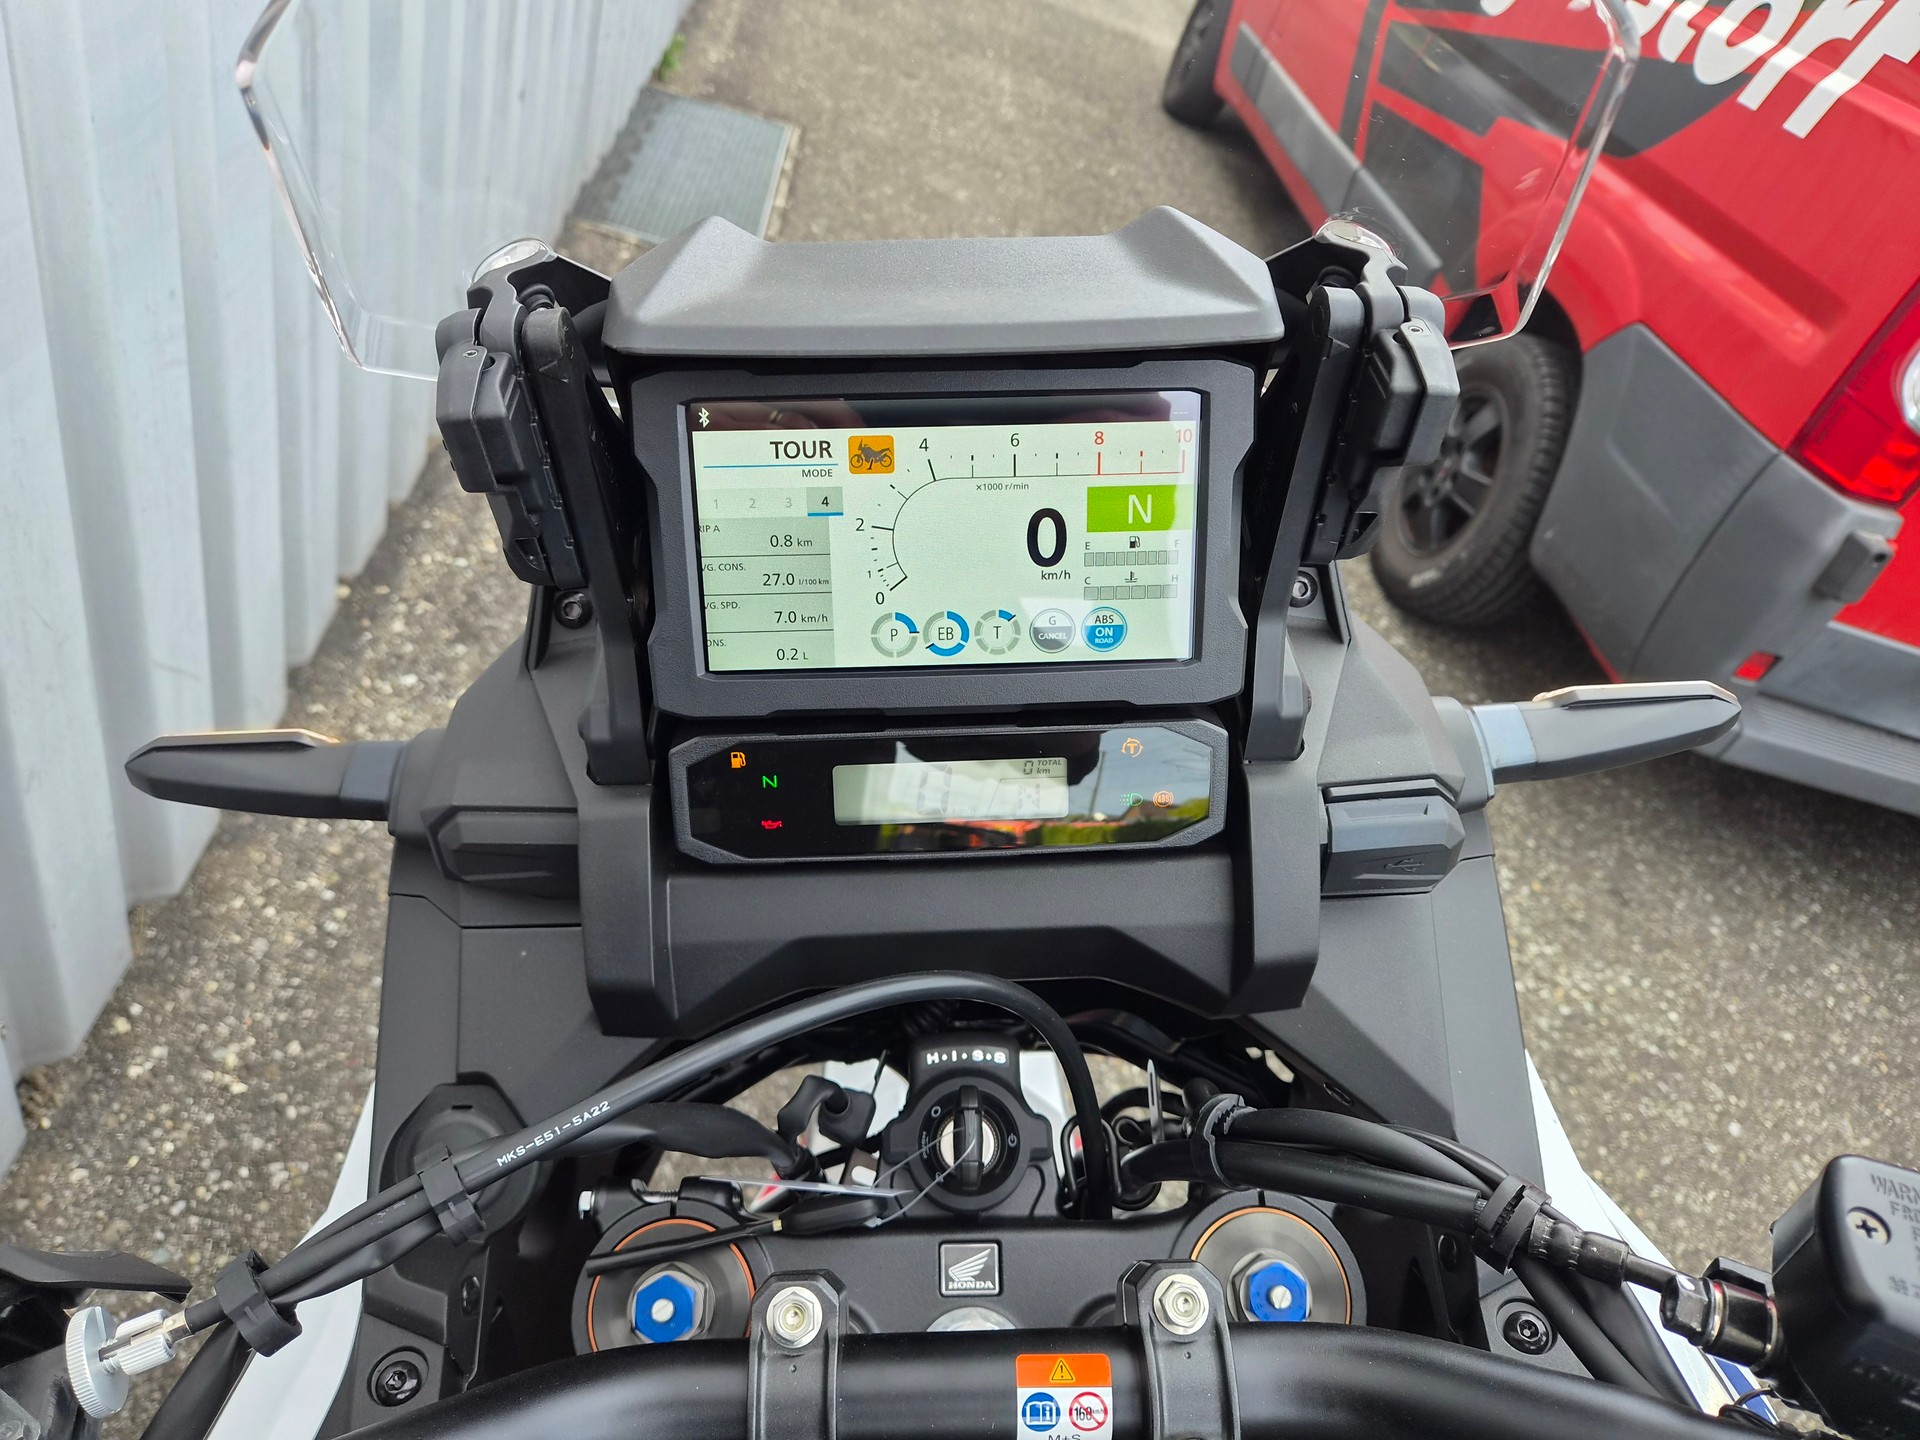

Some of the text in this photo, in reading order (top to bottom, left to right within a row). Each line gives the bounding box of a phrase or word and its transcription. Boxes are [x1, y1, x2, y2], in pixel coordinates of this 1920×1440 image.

[1010, 433, 1020, 447] 6
[1094, 431, 1105, 445] 8
[1176, 428, 1193, 443] 10
[769, 440, 833, 460] TOUR
[919, 438, 930, 452] 4
[801, 468, 833, 478] MODE
[1005, 482, 1030, 491] r/min
[713, 496, 830, 509] 1 2 3 4
[1127, 494, 1153, 524] N
[713, 524, 721, 533] A
[855, 517, 866, 531] 2
[769, 534, 813, 548] 0.8 km
[1026, 507, 1068, 568] 0
[1174, 539, 1180, 548] F
[1085, 542, 1091, 551] E
[718, 563, 746, 572] CONS.
[762, 573, 795, 587] 27.0
[867, 570, 872, 579] 1
[1040, 570, 1071, 581] km/h
[1084, 577, 1091, 585] C
[1171, 574, 1178, 583] H
[875, 592, 885, 605] 0
[720, 601, 741, 610] SPD.
[774, 611, 828, 624] 7.0 km/h
[1048, 616, 1057, 625] G
[1094, 615, 1114, 624] ABS
[890, 628, 899, 642] P
[938, 627, 954, 641] EB
[993, 626, 1002, 639] T
[1038, 632, 1067, 640] CANCEL
[1095, 627, 1114, 637] ON
[776, 648, 809, 661] 0.2 L
[1023, 760, 1034, 775] 0
[762, 775, 778, 788] N
[496, 1100, 611, 1167] MKS-E51-5A22
[948, 1280, 995, 1290] HONDA
